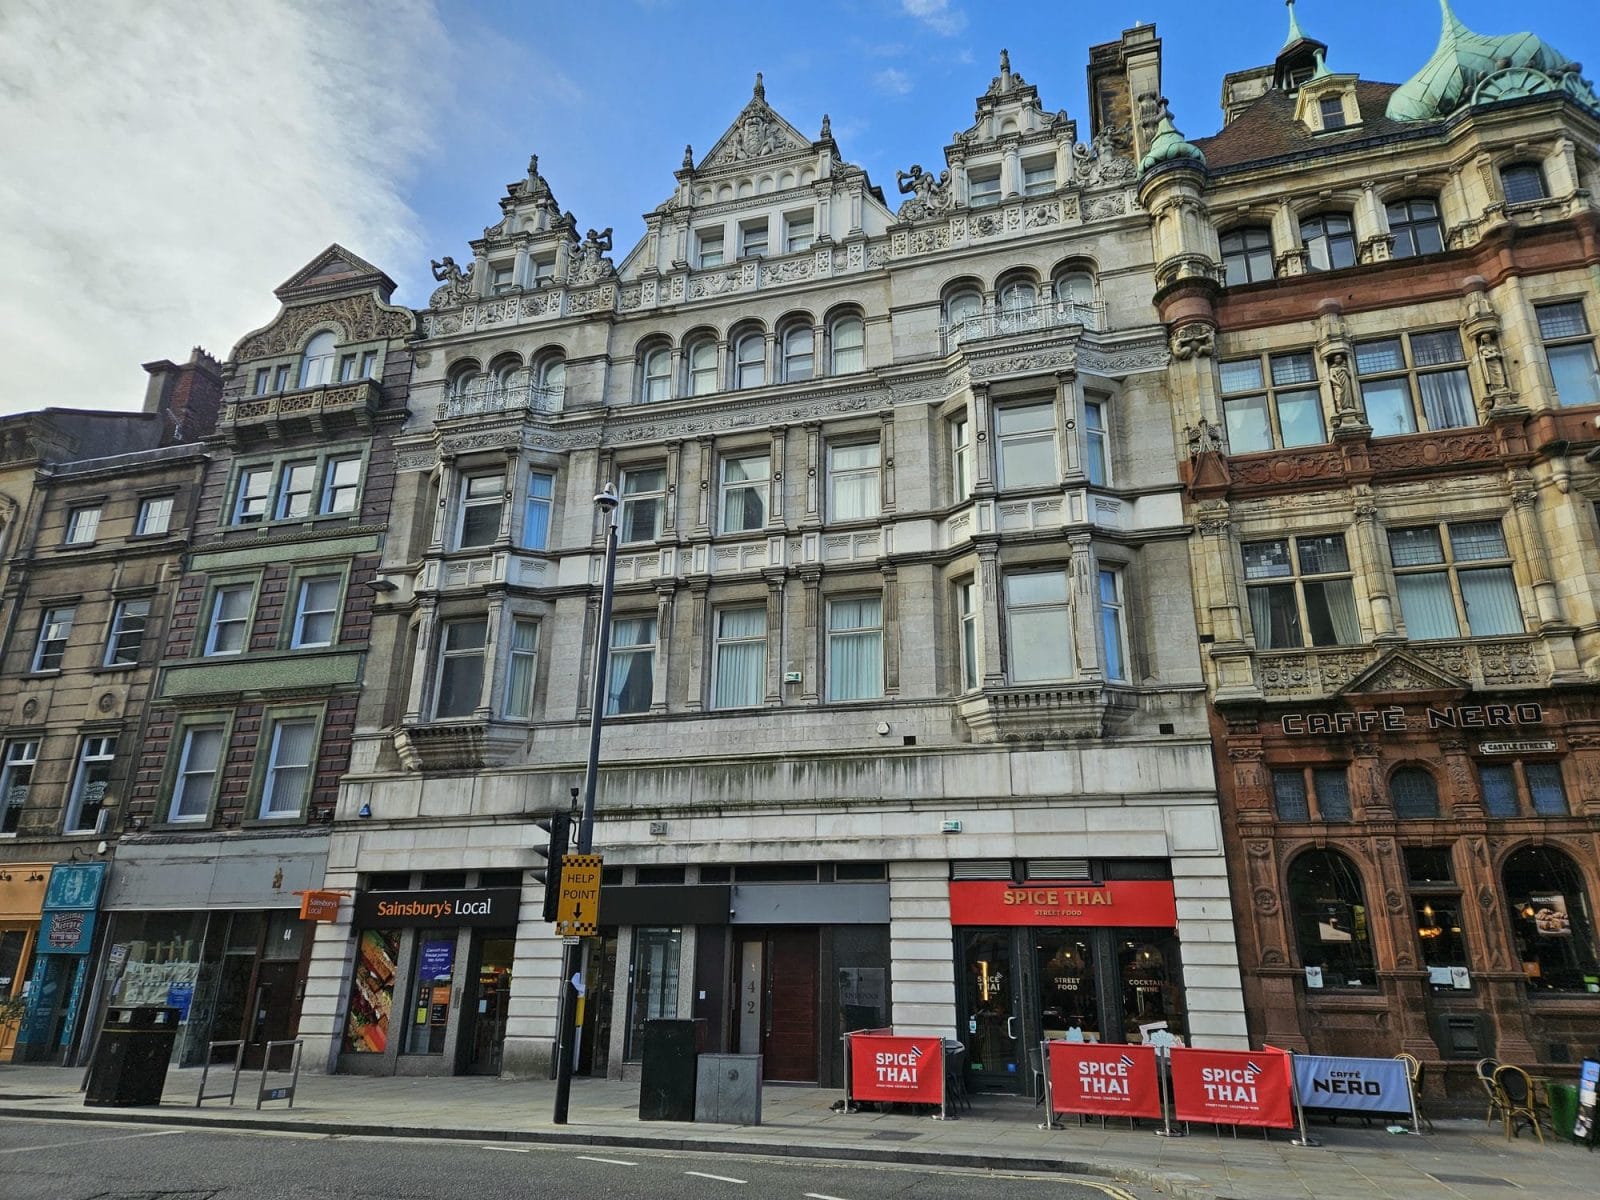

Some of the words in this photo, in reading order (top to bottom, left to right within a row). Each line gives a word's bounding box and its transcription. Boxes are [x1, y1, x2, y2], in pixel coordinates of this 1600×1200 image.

[1282, 706, 1407, 734] CAFFÈ
[1426, 703, 1543, 728] NERO
[567, 874, 595, 883] HELP
[563, 890, 596, 899] POINT
[1003, 891, 1059, 905] SPICE
[1064, 891, 1112, 905] THAI
[310, 899, 337, 908] Sainsbury's
[377, 900, 452, 918] Sainsbury's
[455, 898, 491, 914] Local
[283, 929, 292, 941] 44
[876, 1053, 917, 1066] SPICE
[876, 1067, 917, 1082] THAI
[1079, 1061, 1128, 1076] SPICE
[1202, 1068, 1256, 1084] SPICE
[1330, 1070, 1361, 1078] CAFFÈ
[1080, 1077, 1129, 1094] THAI
[1313, 1078, 1381, 1095] NERO
[1203, 1084, 1257, 1103] THAI
